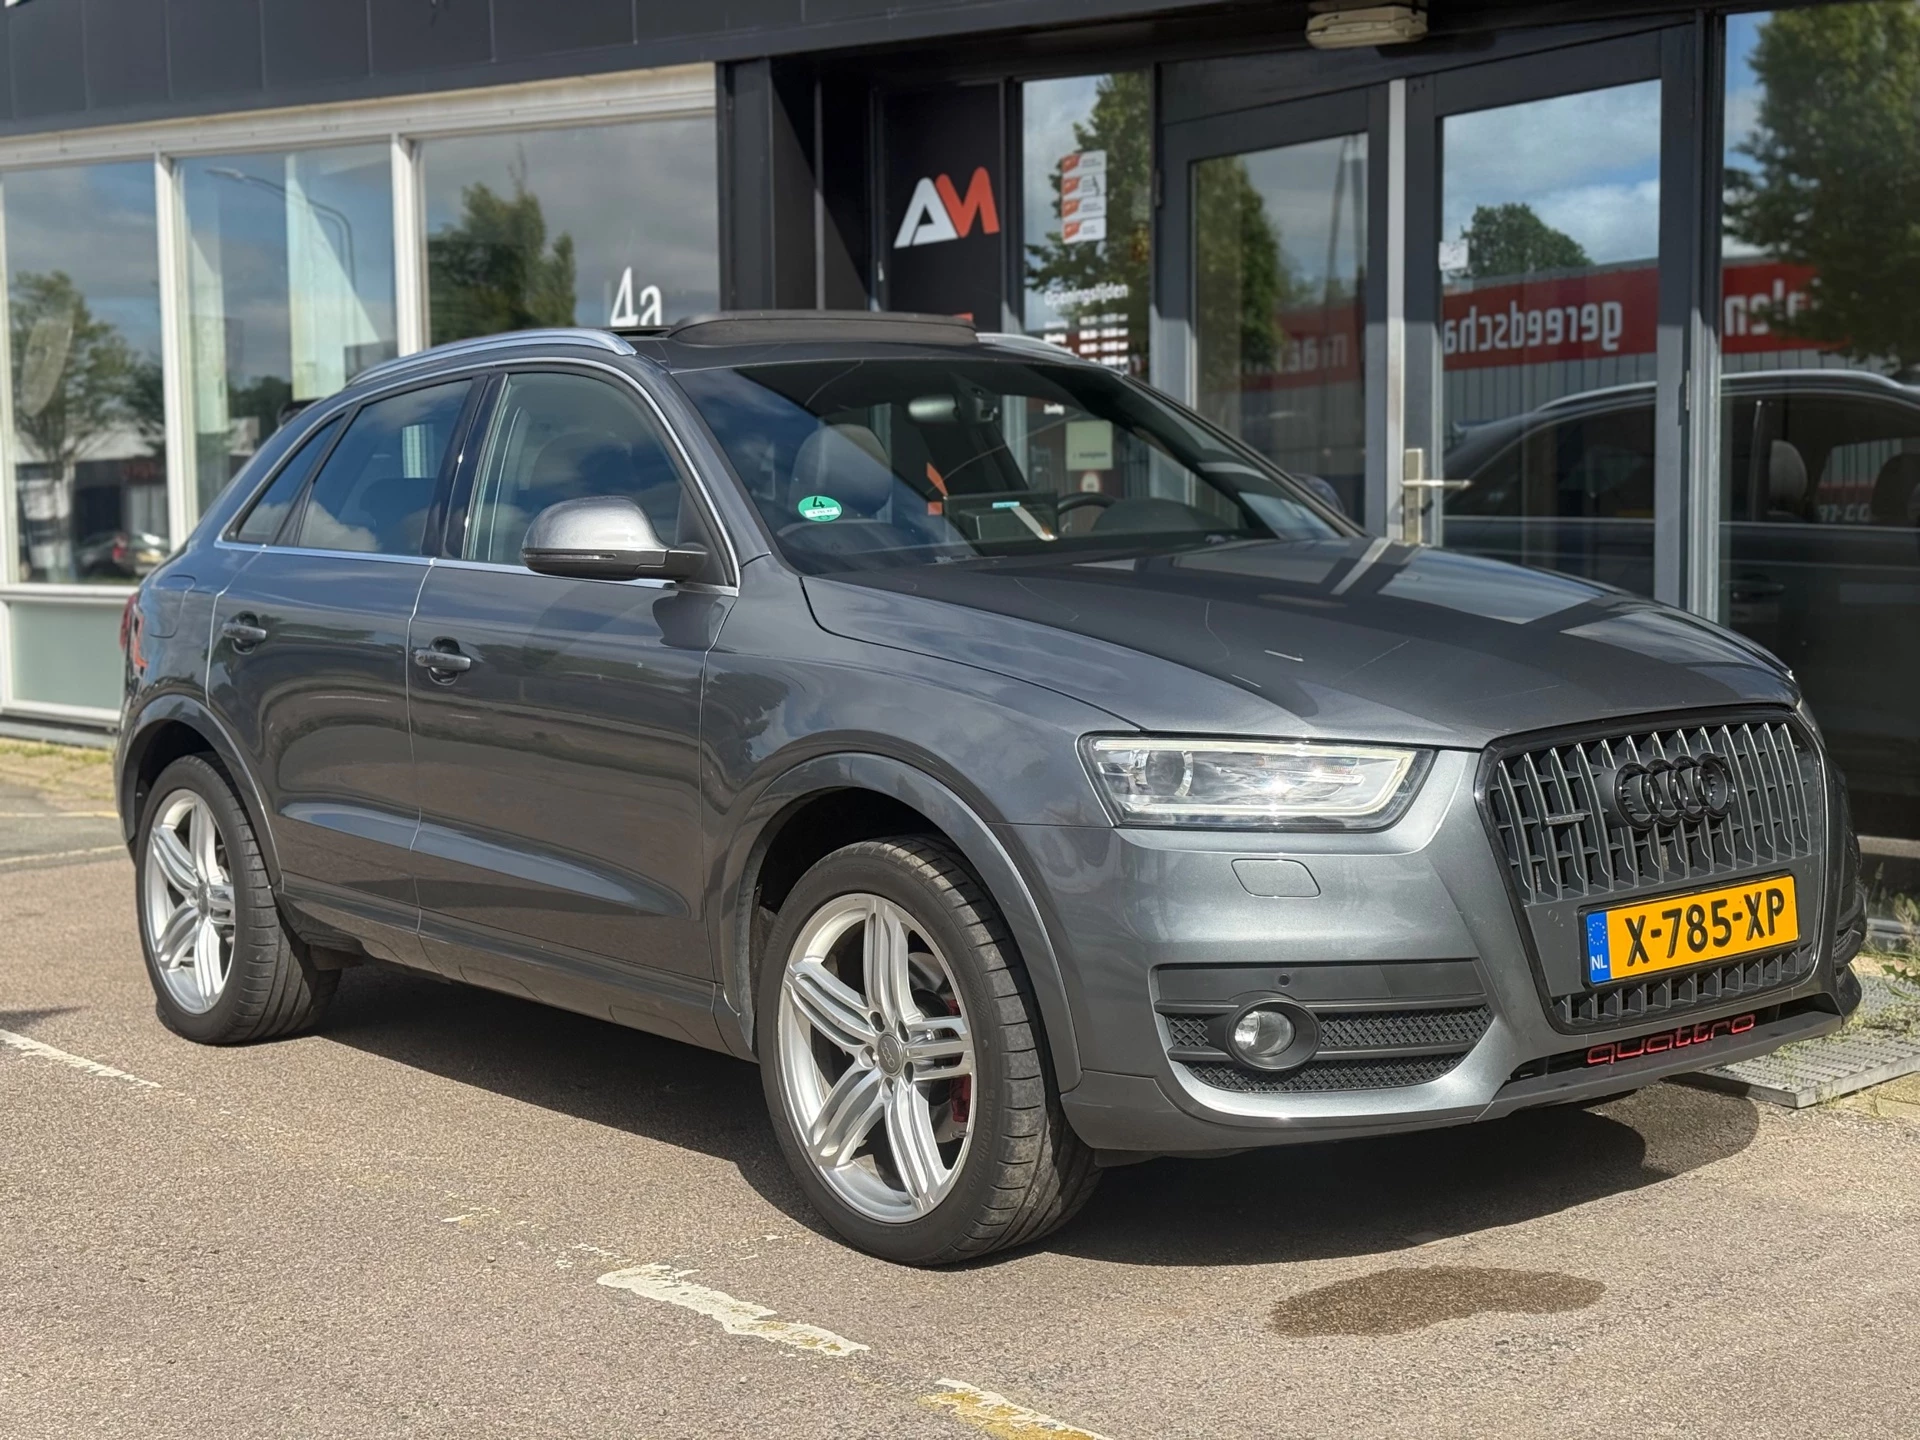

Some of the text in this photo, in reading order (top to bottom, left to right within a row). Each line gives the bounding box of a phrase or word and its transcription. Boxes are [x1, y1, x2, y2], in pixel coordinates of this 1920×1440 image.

[894, 166, 1000, 249] AM
[610, 266, 662, 327] 4a
[812, 496, 826, 508] 4
[1624, 888, 1785, 967] X-785-XP
[1590, 954, 1608, 971] NL
[1587, 1013, 1756, 1065] quattro
